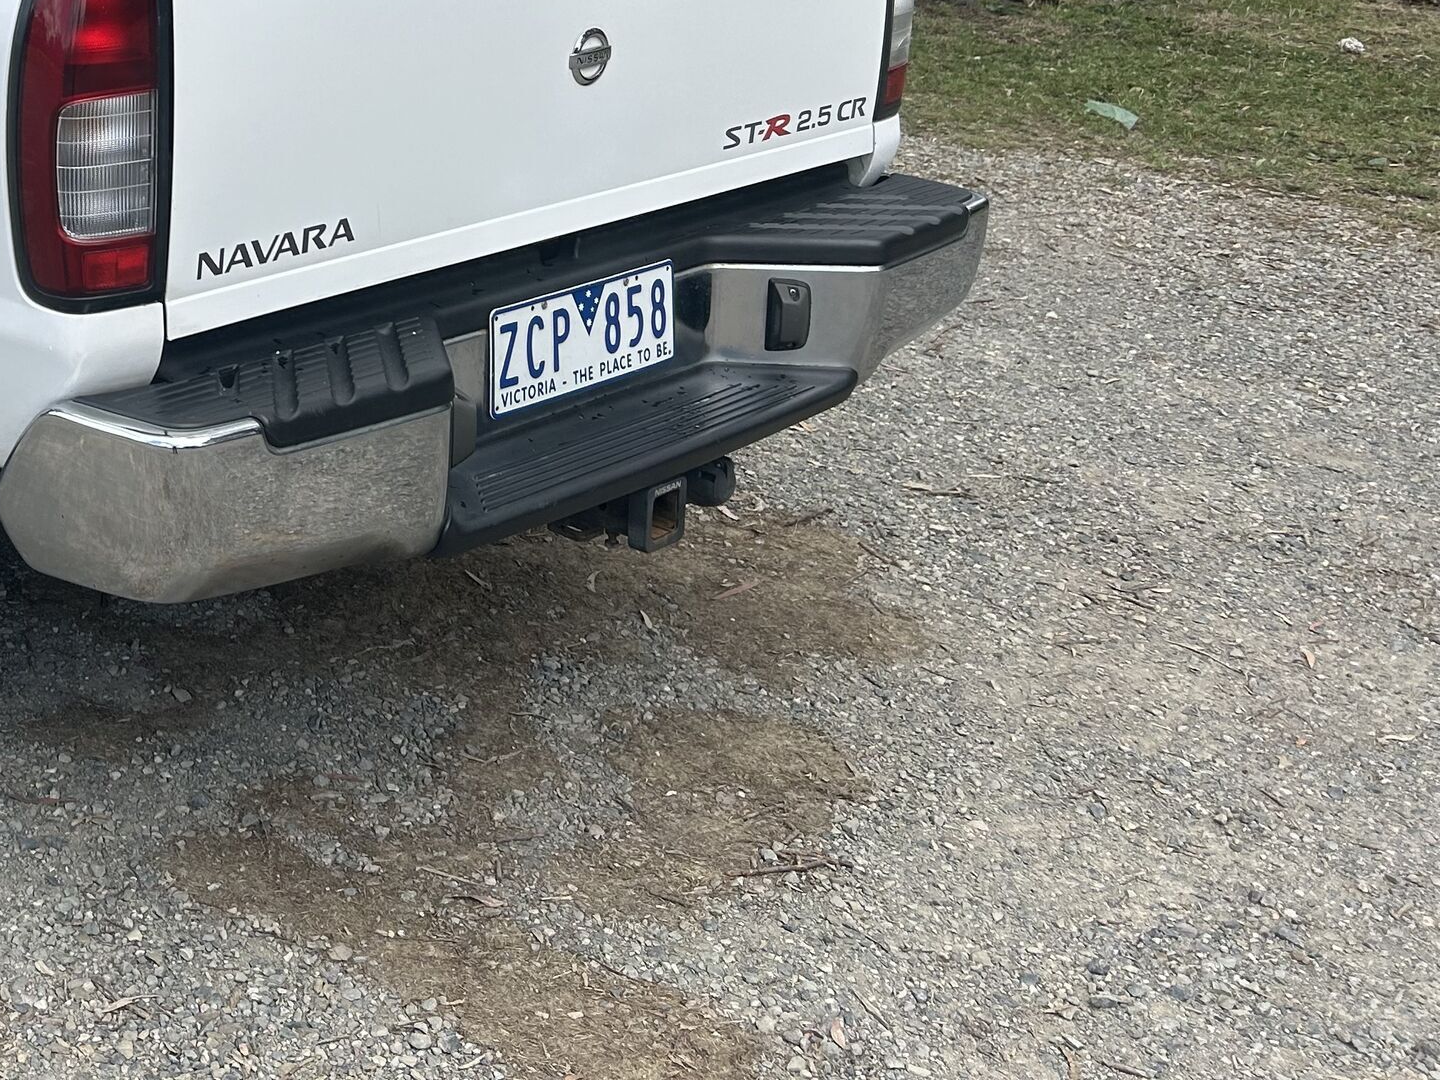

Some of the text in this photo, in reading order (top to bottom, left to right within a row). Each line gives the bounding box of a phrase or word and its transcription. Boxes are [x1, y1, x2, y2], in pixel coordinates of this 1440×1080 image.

[796, 104, 833, 133] 2.5
[836, 96, 867, 122] CR
[196, 217, 356, 281] NAVARA
[499, 278, 667, 389] ZCP 858
[500, 377, 557, 408] VICTORIA
[572, 365, 594, 386] THE
[599, 353, 633, 377] PLACE
[637, 347, 651, 365] TO
